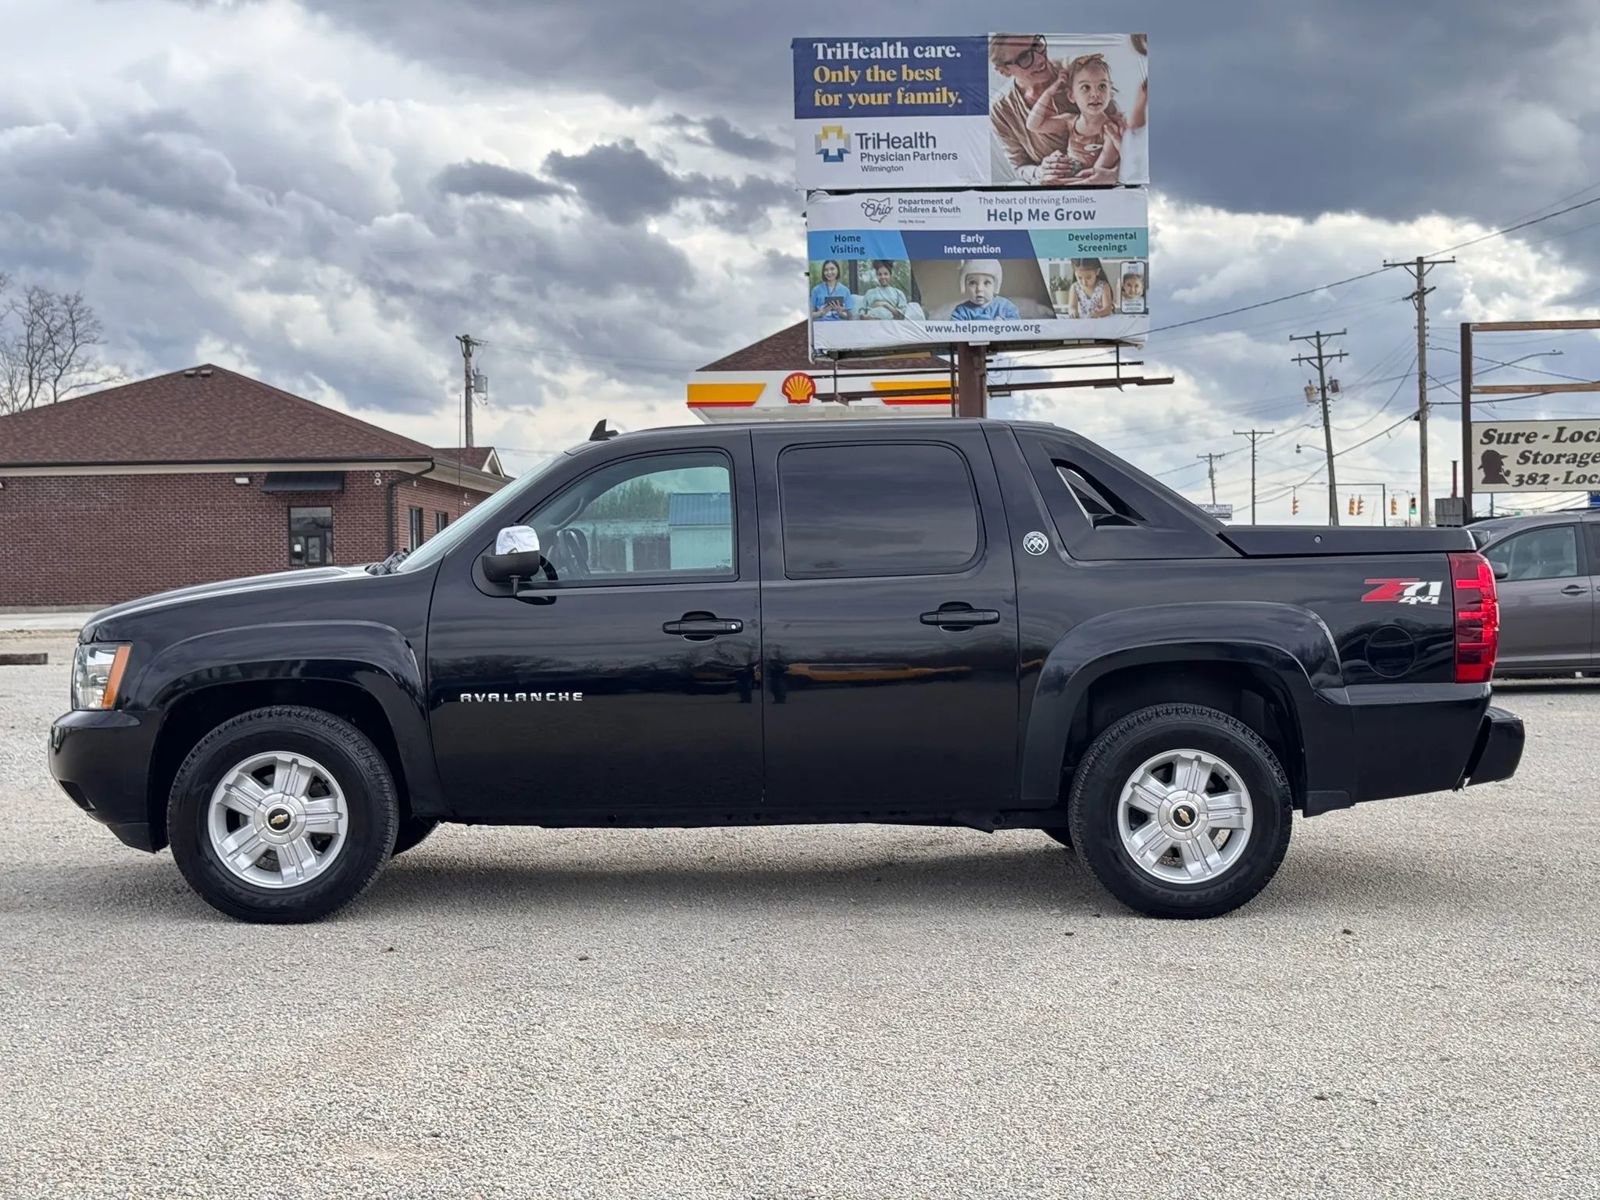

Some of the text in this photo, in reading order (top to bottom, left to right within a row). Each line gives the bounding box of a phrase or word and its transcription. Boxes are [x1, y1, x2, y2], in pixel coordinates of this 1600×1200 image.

[813, 41, 962, 60] TriHealth care.
[813, 64, 942, 86] Only the best
[814, 86, 963, 109] for your family.
[855, 131, 937, 150] TriHealth
[860, 151, 958, 165] Physician Partners
[861, 165, 904, 173] Wilmington
[898, 197, 953, 207] Department of
[978, 195, 1097, 206] The heart of thriving families.
[861, 201, 893, 218] Ohio
[898, 206, 929, 214] Children
[939, 206, 961, 214] Youth
[987, 208, 1096, 225] Help Me Grow
[834, 234, 862, 243] Home
[960, 233, 985, 245] Early
[1068, 231, 1137, 242] Developmental
[830, 244, 866, 256] Visiting
[943, 244, 1002, 255] Intervention
[1077, 243, 1128, 254] Screenings
[924, 323, 1041, 336] www.helpmegrow.org
[1516, 449, 1600, 469] Storage
[1361, 577, 1443, 602] Z71
[460, 692, 583, 703] AVALANCHE
